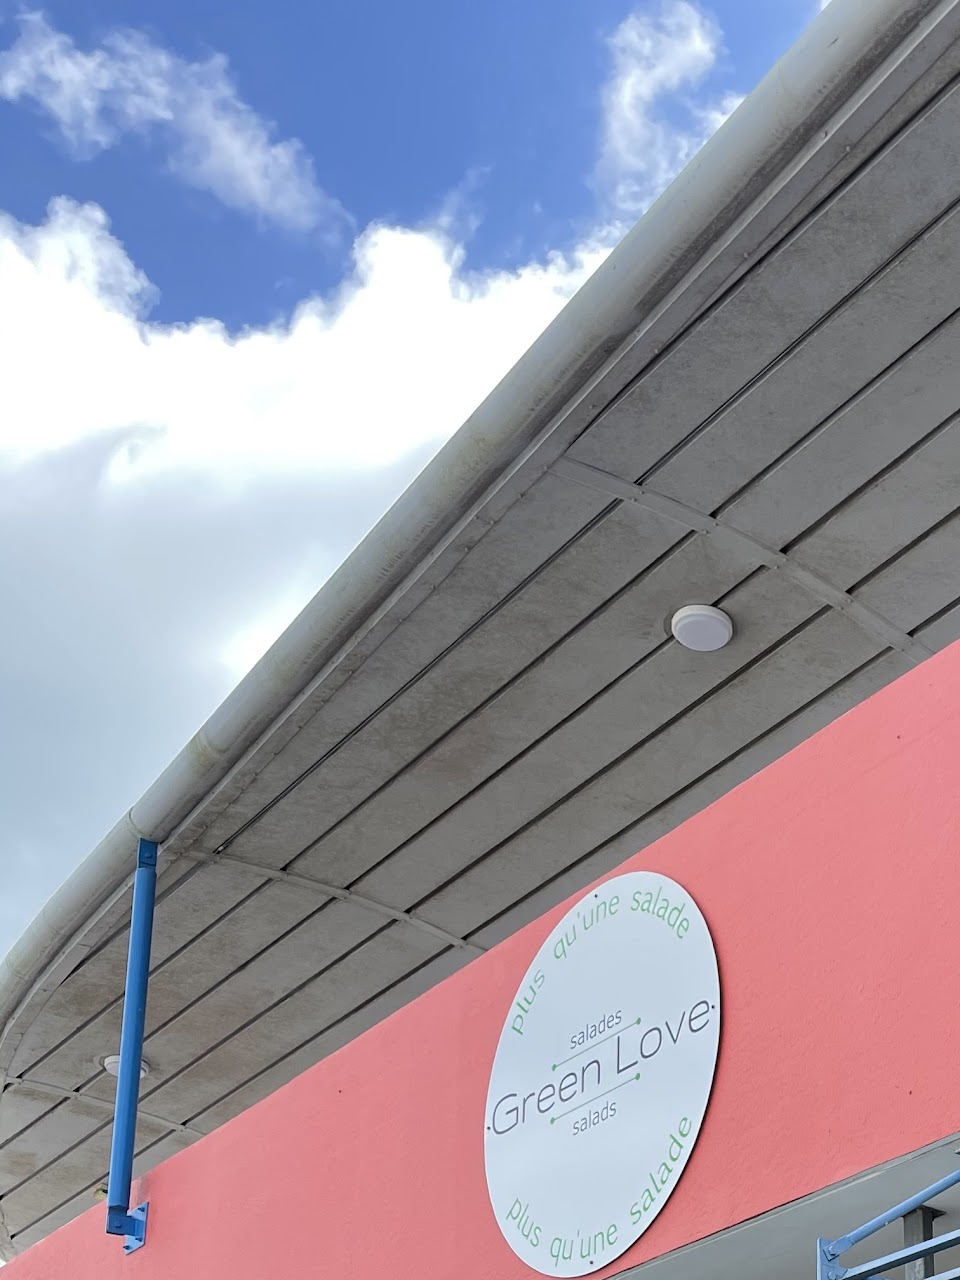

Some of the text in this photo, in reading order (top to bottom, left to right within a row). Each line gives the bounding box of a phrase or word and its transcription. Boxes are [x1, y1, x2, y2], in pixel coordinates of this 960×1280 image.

[511, 886, 691, 1035] plus qu'une salade
[492, 999, 711, 1135] Green Love
[570, 1008, 623, 1050] salades
[572, 1099, 617, 1136] salads
[506, 1116, 692, 1267] plus qu'une salade
